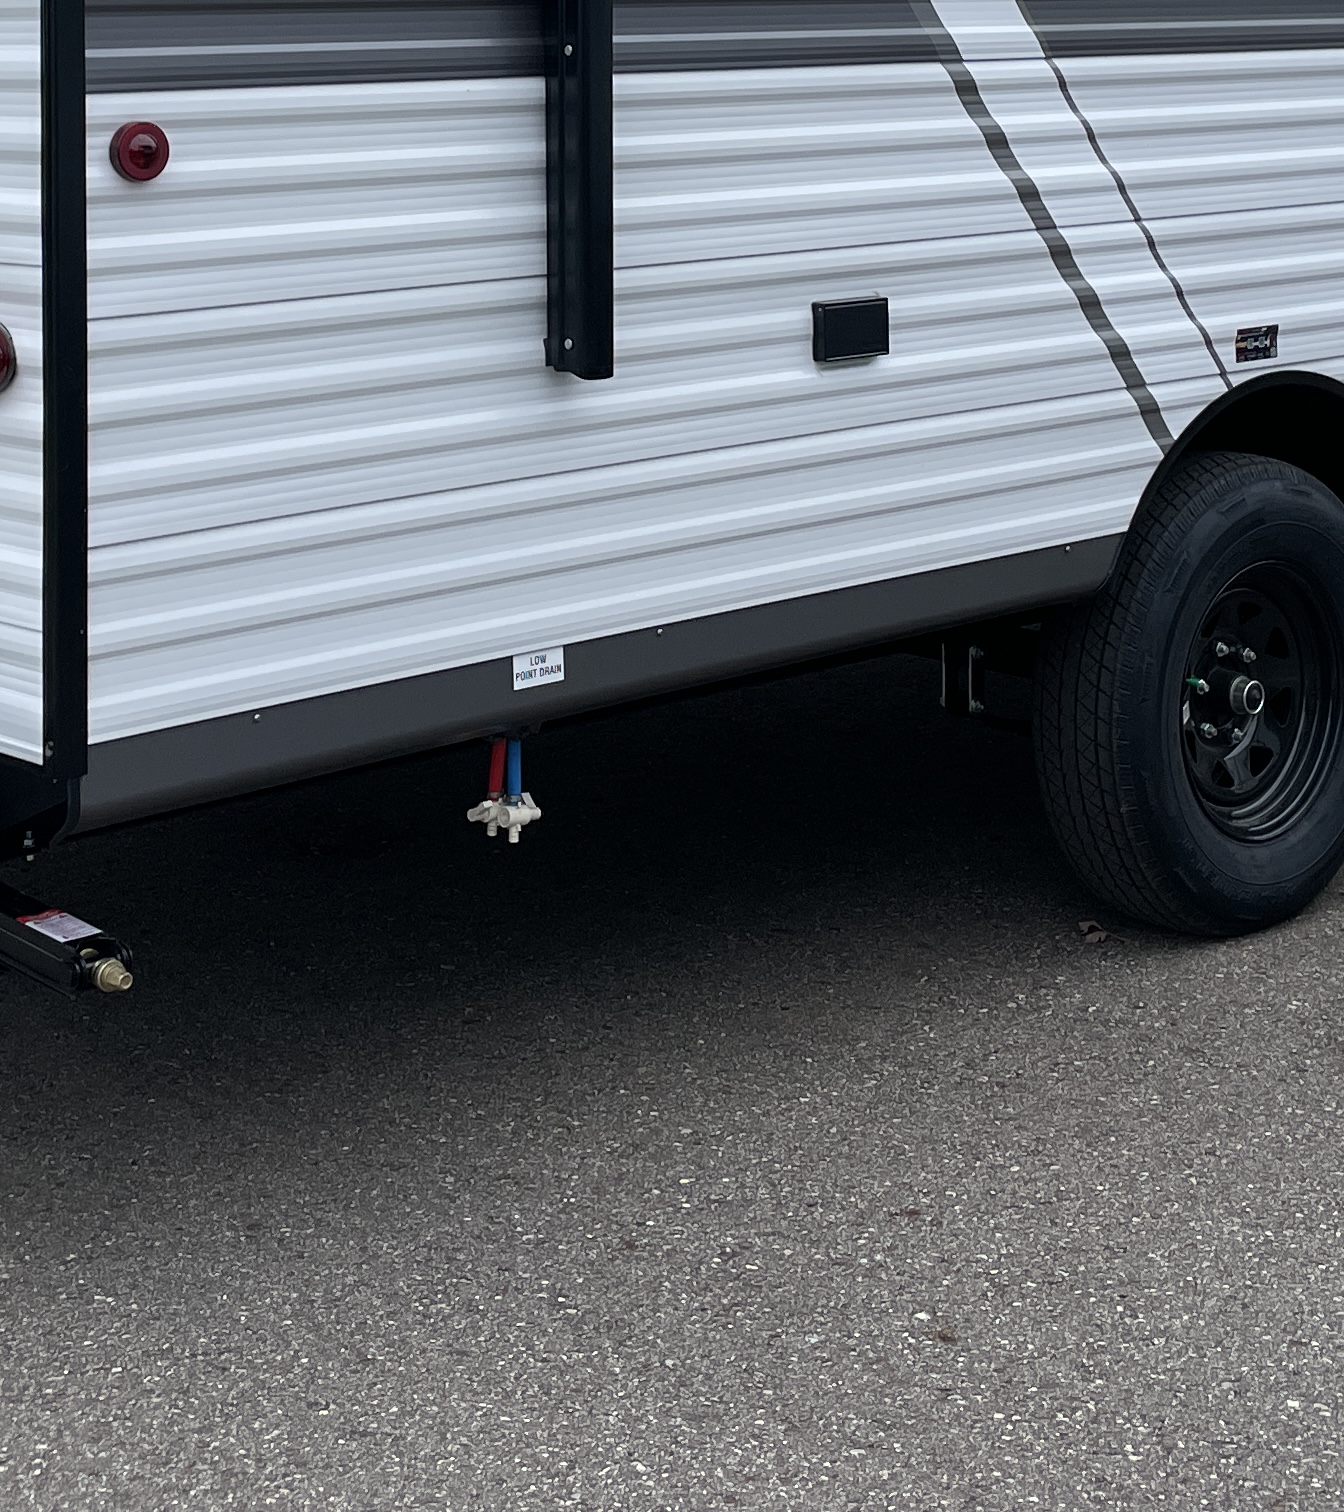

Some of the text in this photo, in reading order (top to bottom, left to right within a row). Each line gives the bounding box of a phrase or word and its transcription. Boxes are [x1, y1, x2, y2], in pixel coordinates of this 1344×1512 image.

[530, 654, 547, 666] LOW
[516, 664, 562, 682] POINT DRAIN
